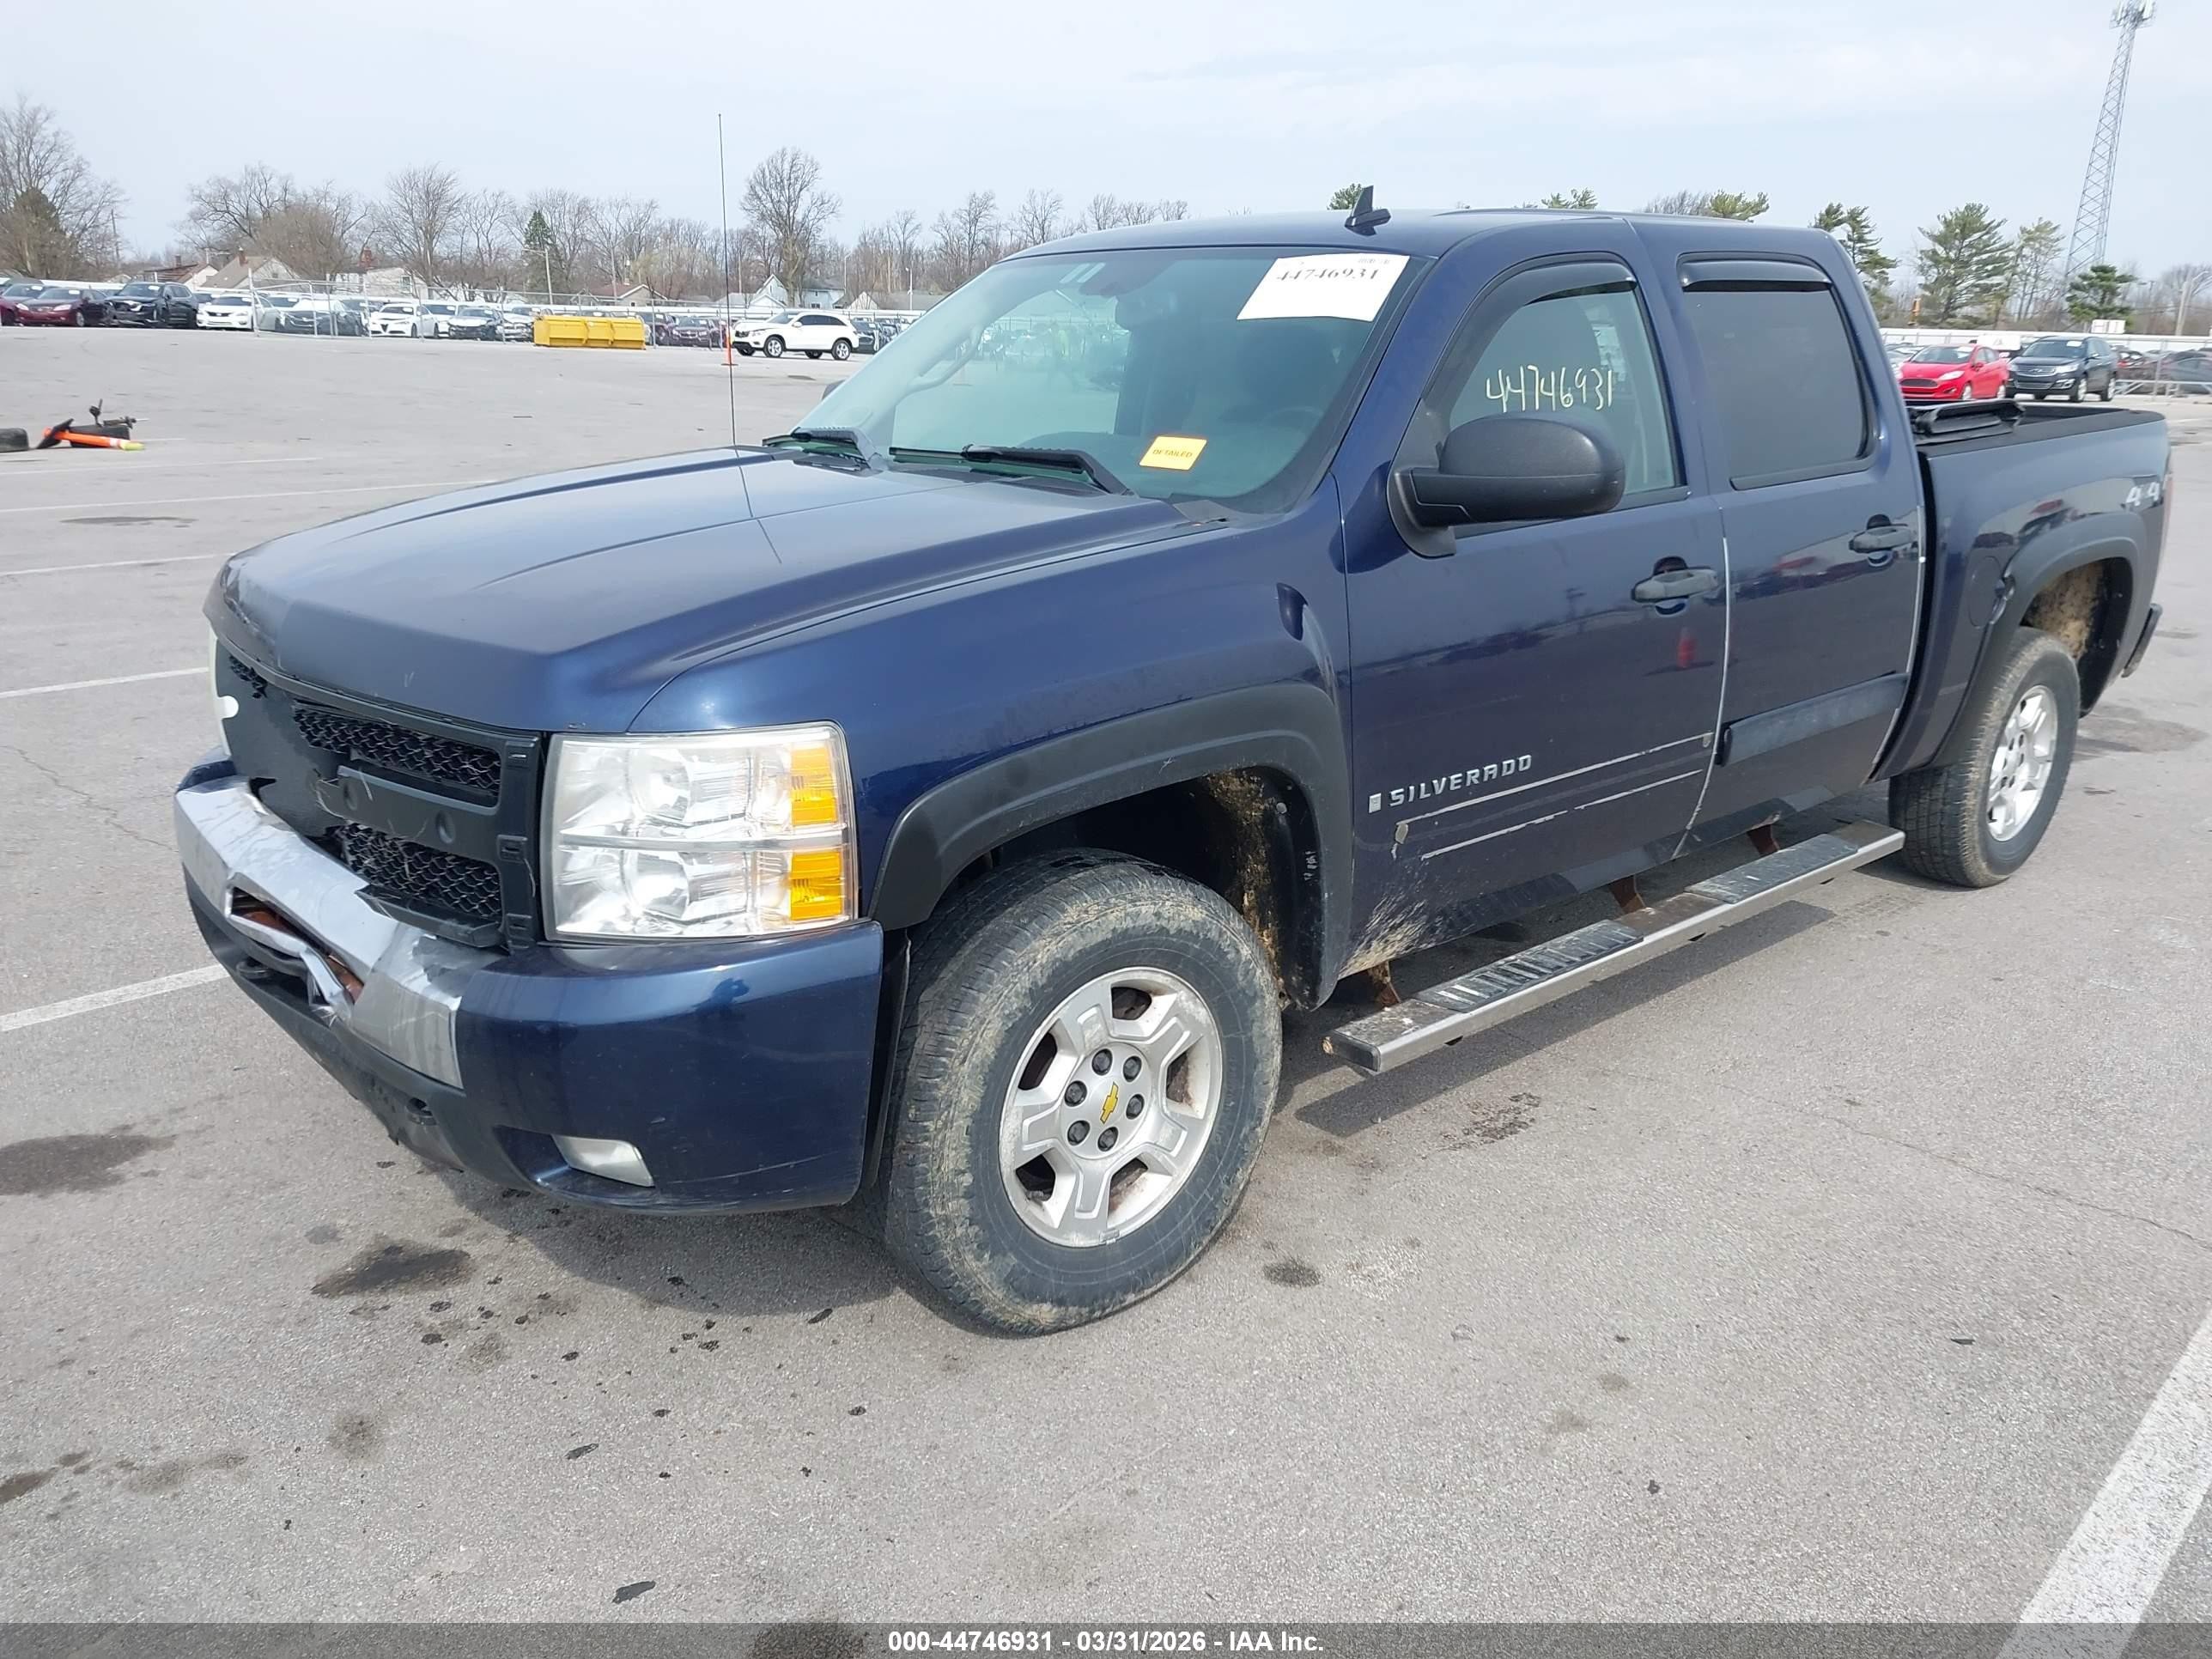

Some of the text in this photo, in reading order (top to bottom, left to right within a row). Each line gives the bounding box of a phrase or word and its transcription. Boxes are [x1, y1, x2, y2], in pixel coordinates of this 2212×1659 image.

[1275, 267, 1379, 281] 44746931
[1486, 365, 1613, 413] 44746931
[1152, 448, 1194, 459] DETAILED
[1389, 754, 1533, 807] SILVERADO
